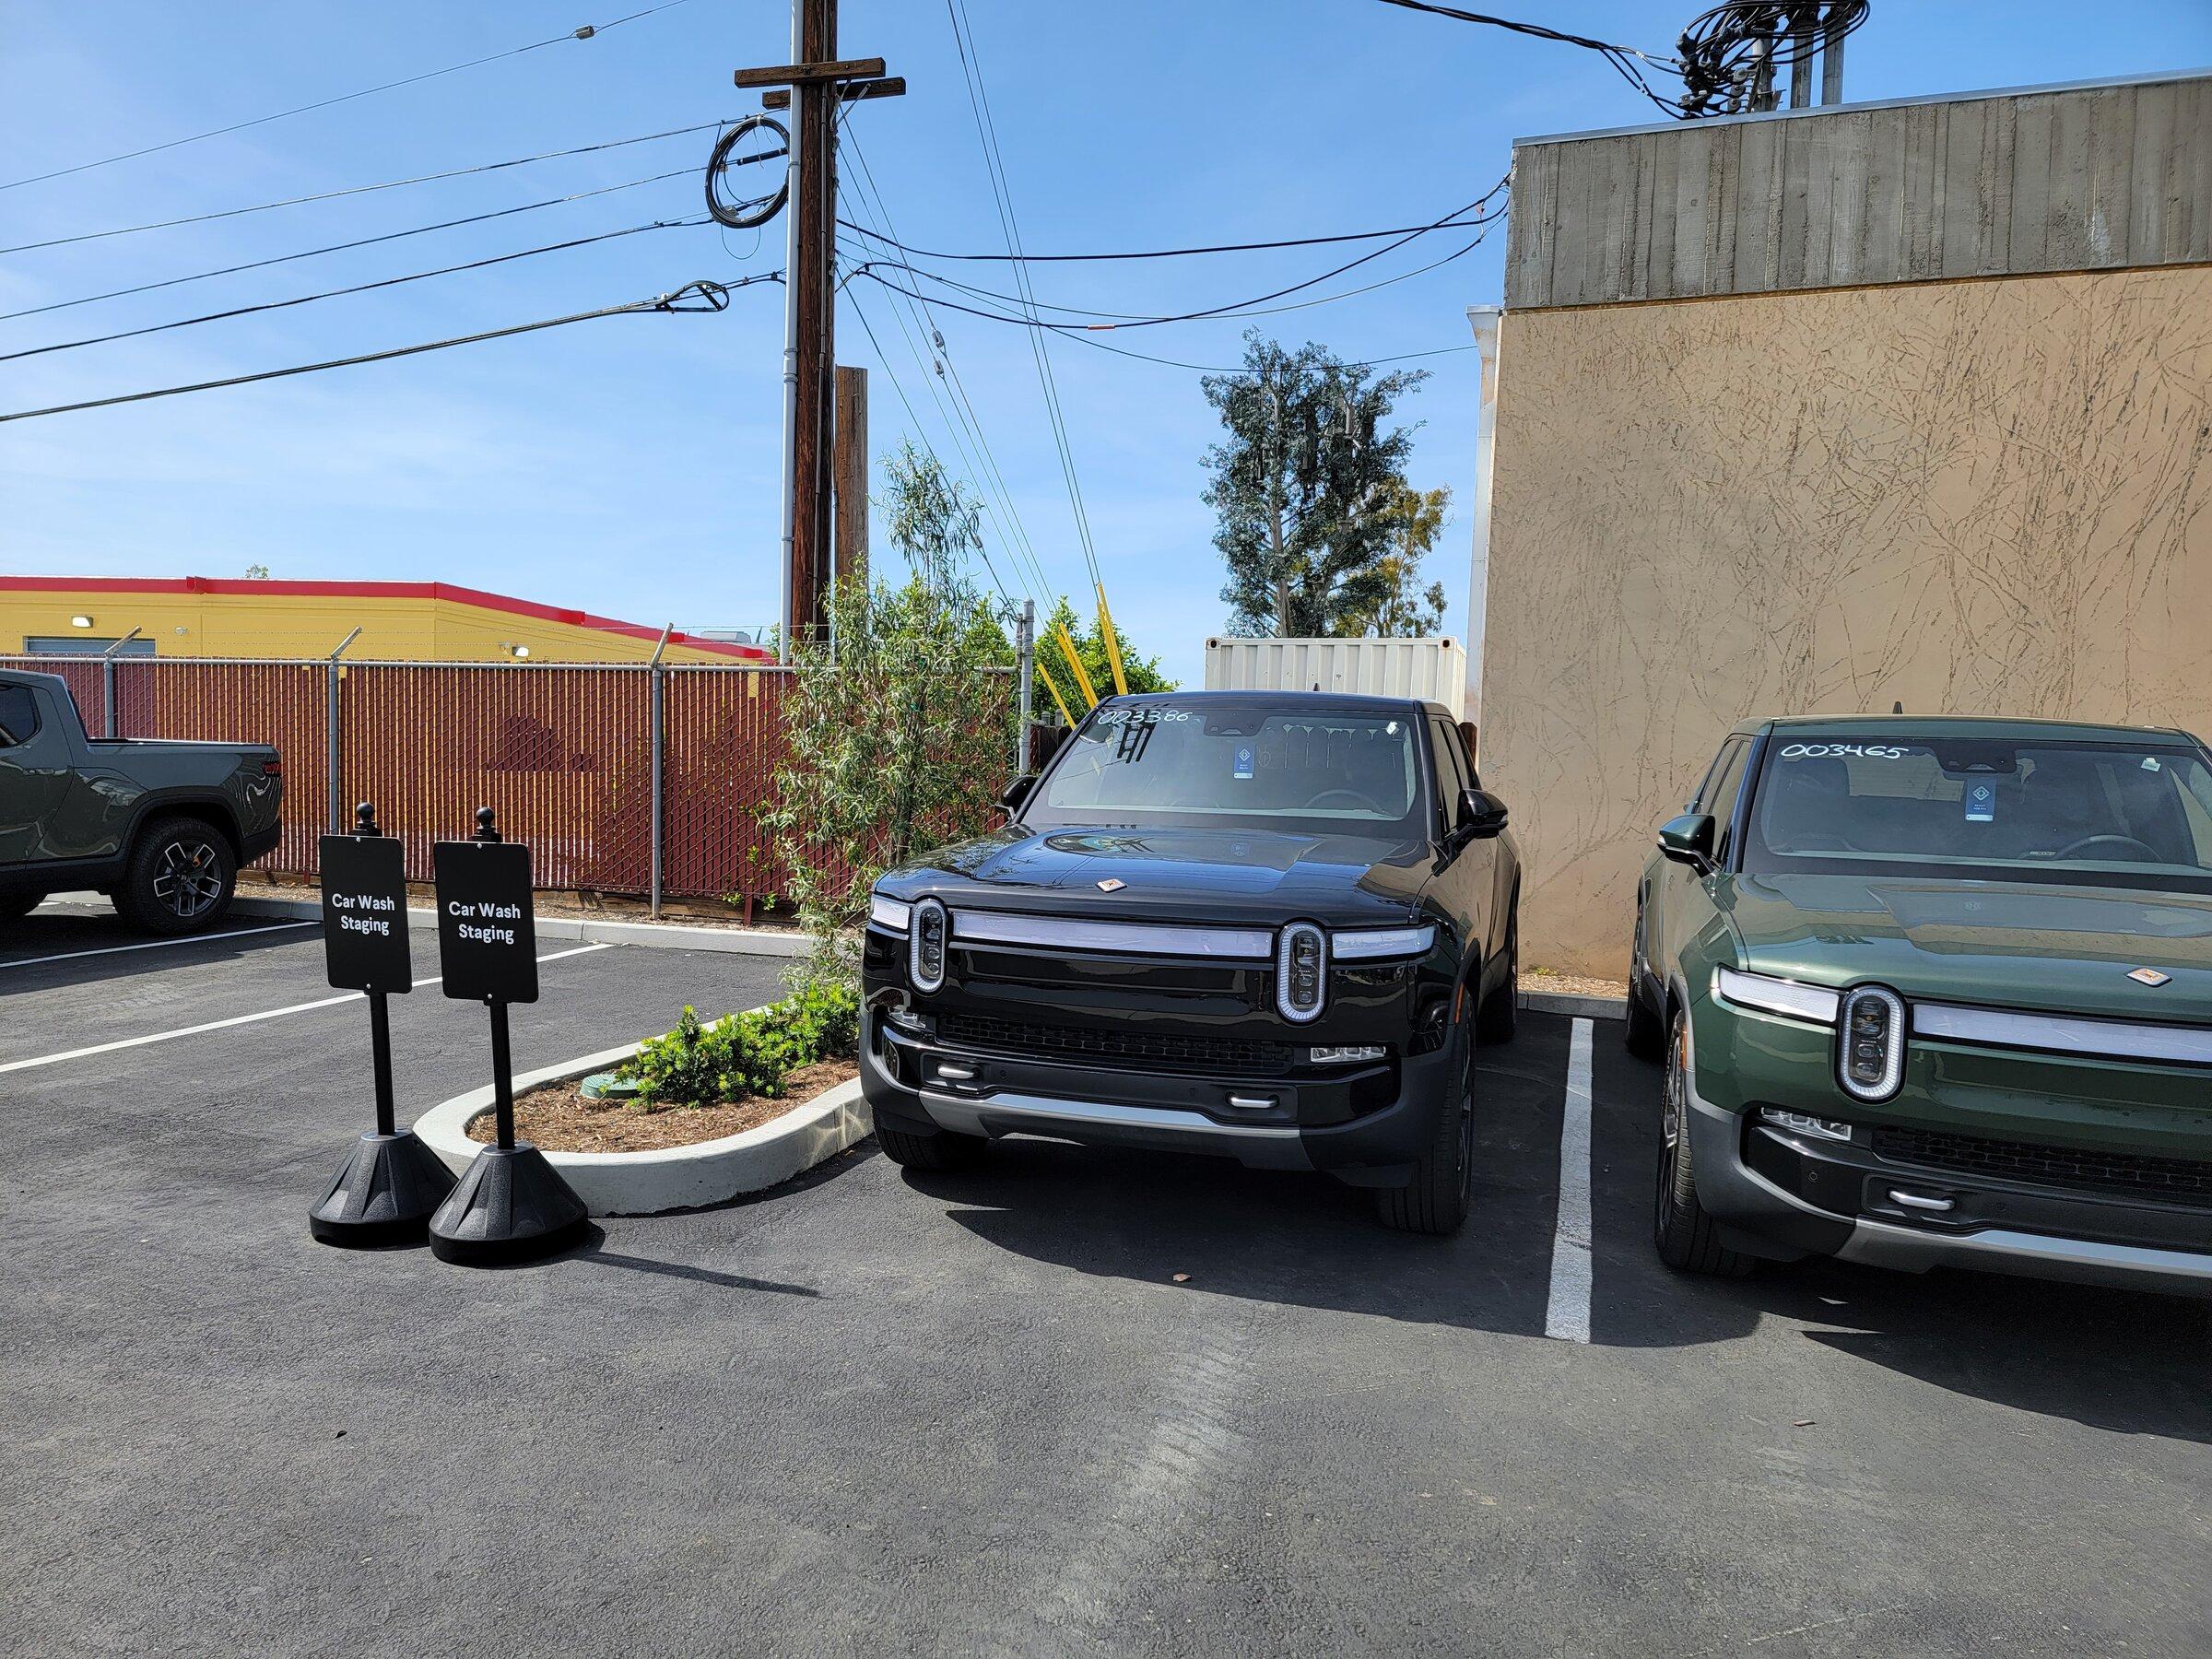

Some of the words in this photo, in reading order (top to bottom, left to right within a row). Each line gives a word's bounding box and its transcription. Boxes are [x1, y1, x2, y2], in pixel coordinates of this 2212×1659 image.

[1098, 709, 1193, 724] 003386
[1781, 744, 1910, 759] 003465
[332, 893, 356, 909] Car
[357, 894, 395, 911] Wash
[448, 900, 476, 917] Car
[478, 902, 521, 919] Wash
[340, 914, 390, 936] Staging
[458, 924, 514, 945] Staging
